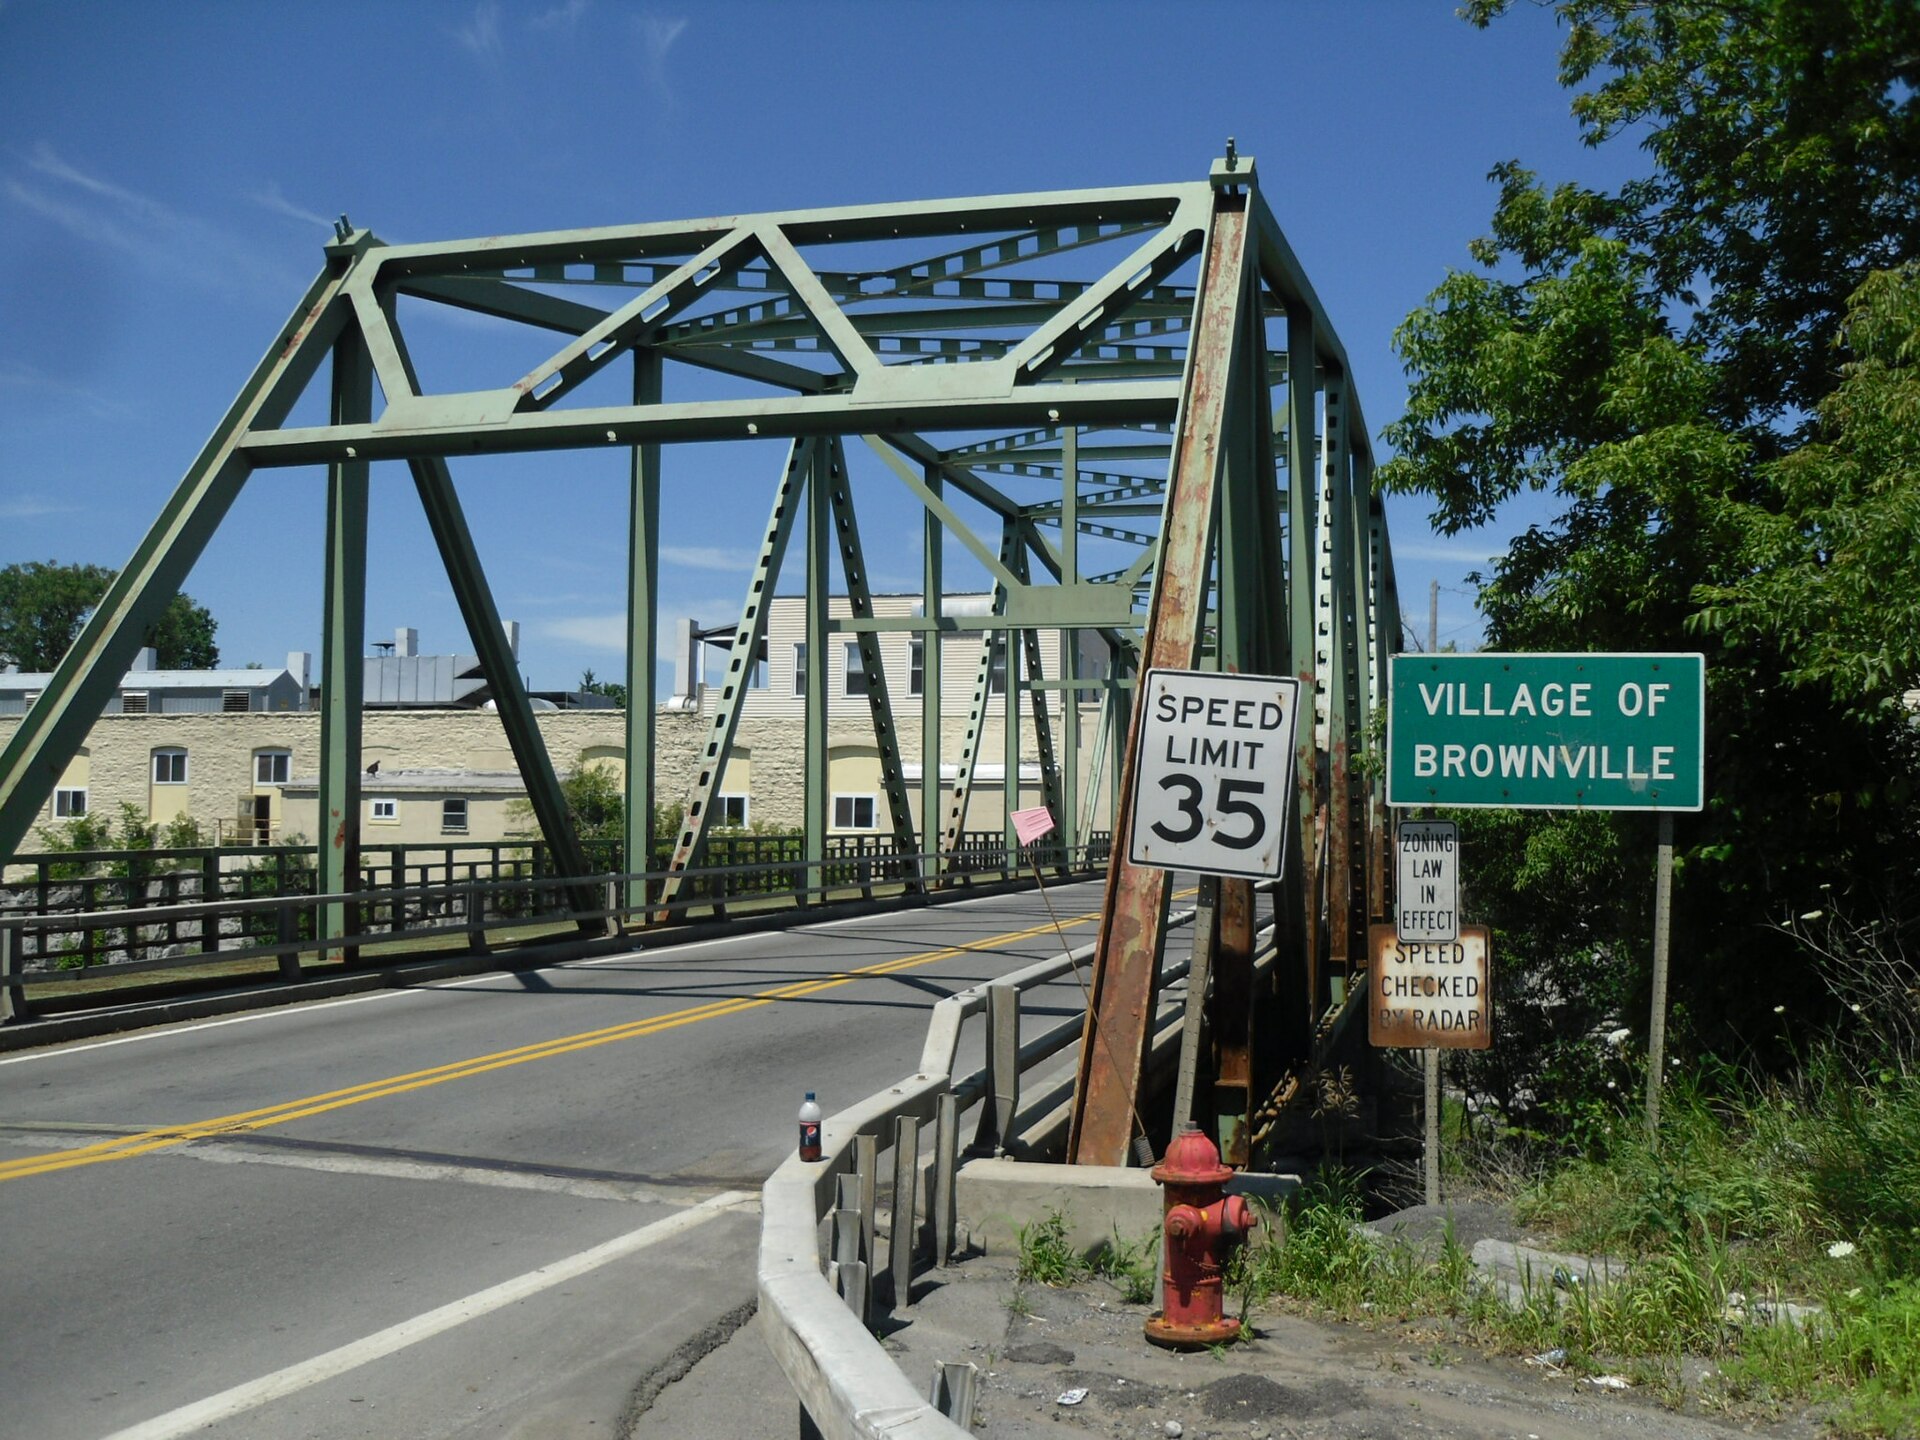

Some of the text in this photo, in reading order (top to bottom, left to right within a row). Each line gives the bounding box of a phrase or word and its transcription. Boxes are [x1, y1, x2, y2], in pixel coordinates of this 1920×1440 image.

[1418, 682, 1670, 717] VILLAGE OF
[1156, 694, 1283, 730] SPEED
[1166, 735, 1264, 770] LIMIT
[1414, 743, 1675, 780] BROWNVILLE
[1150, 773, 1266, 850] 35
[1403, 833, 1453, 853] ZONING
[1412, 859, 1442, 878] LAW
[1421, 885, 1435, 904] IN
[1402, 911, 1453, 930] EFFECT
[1394, 943, 1464, 964] SPEED
[1381, 976, 1479, 997] CHECKED
[1379, 1008, 1480, 1031] BY RADAR
